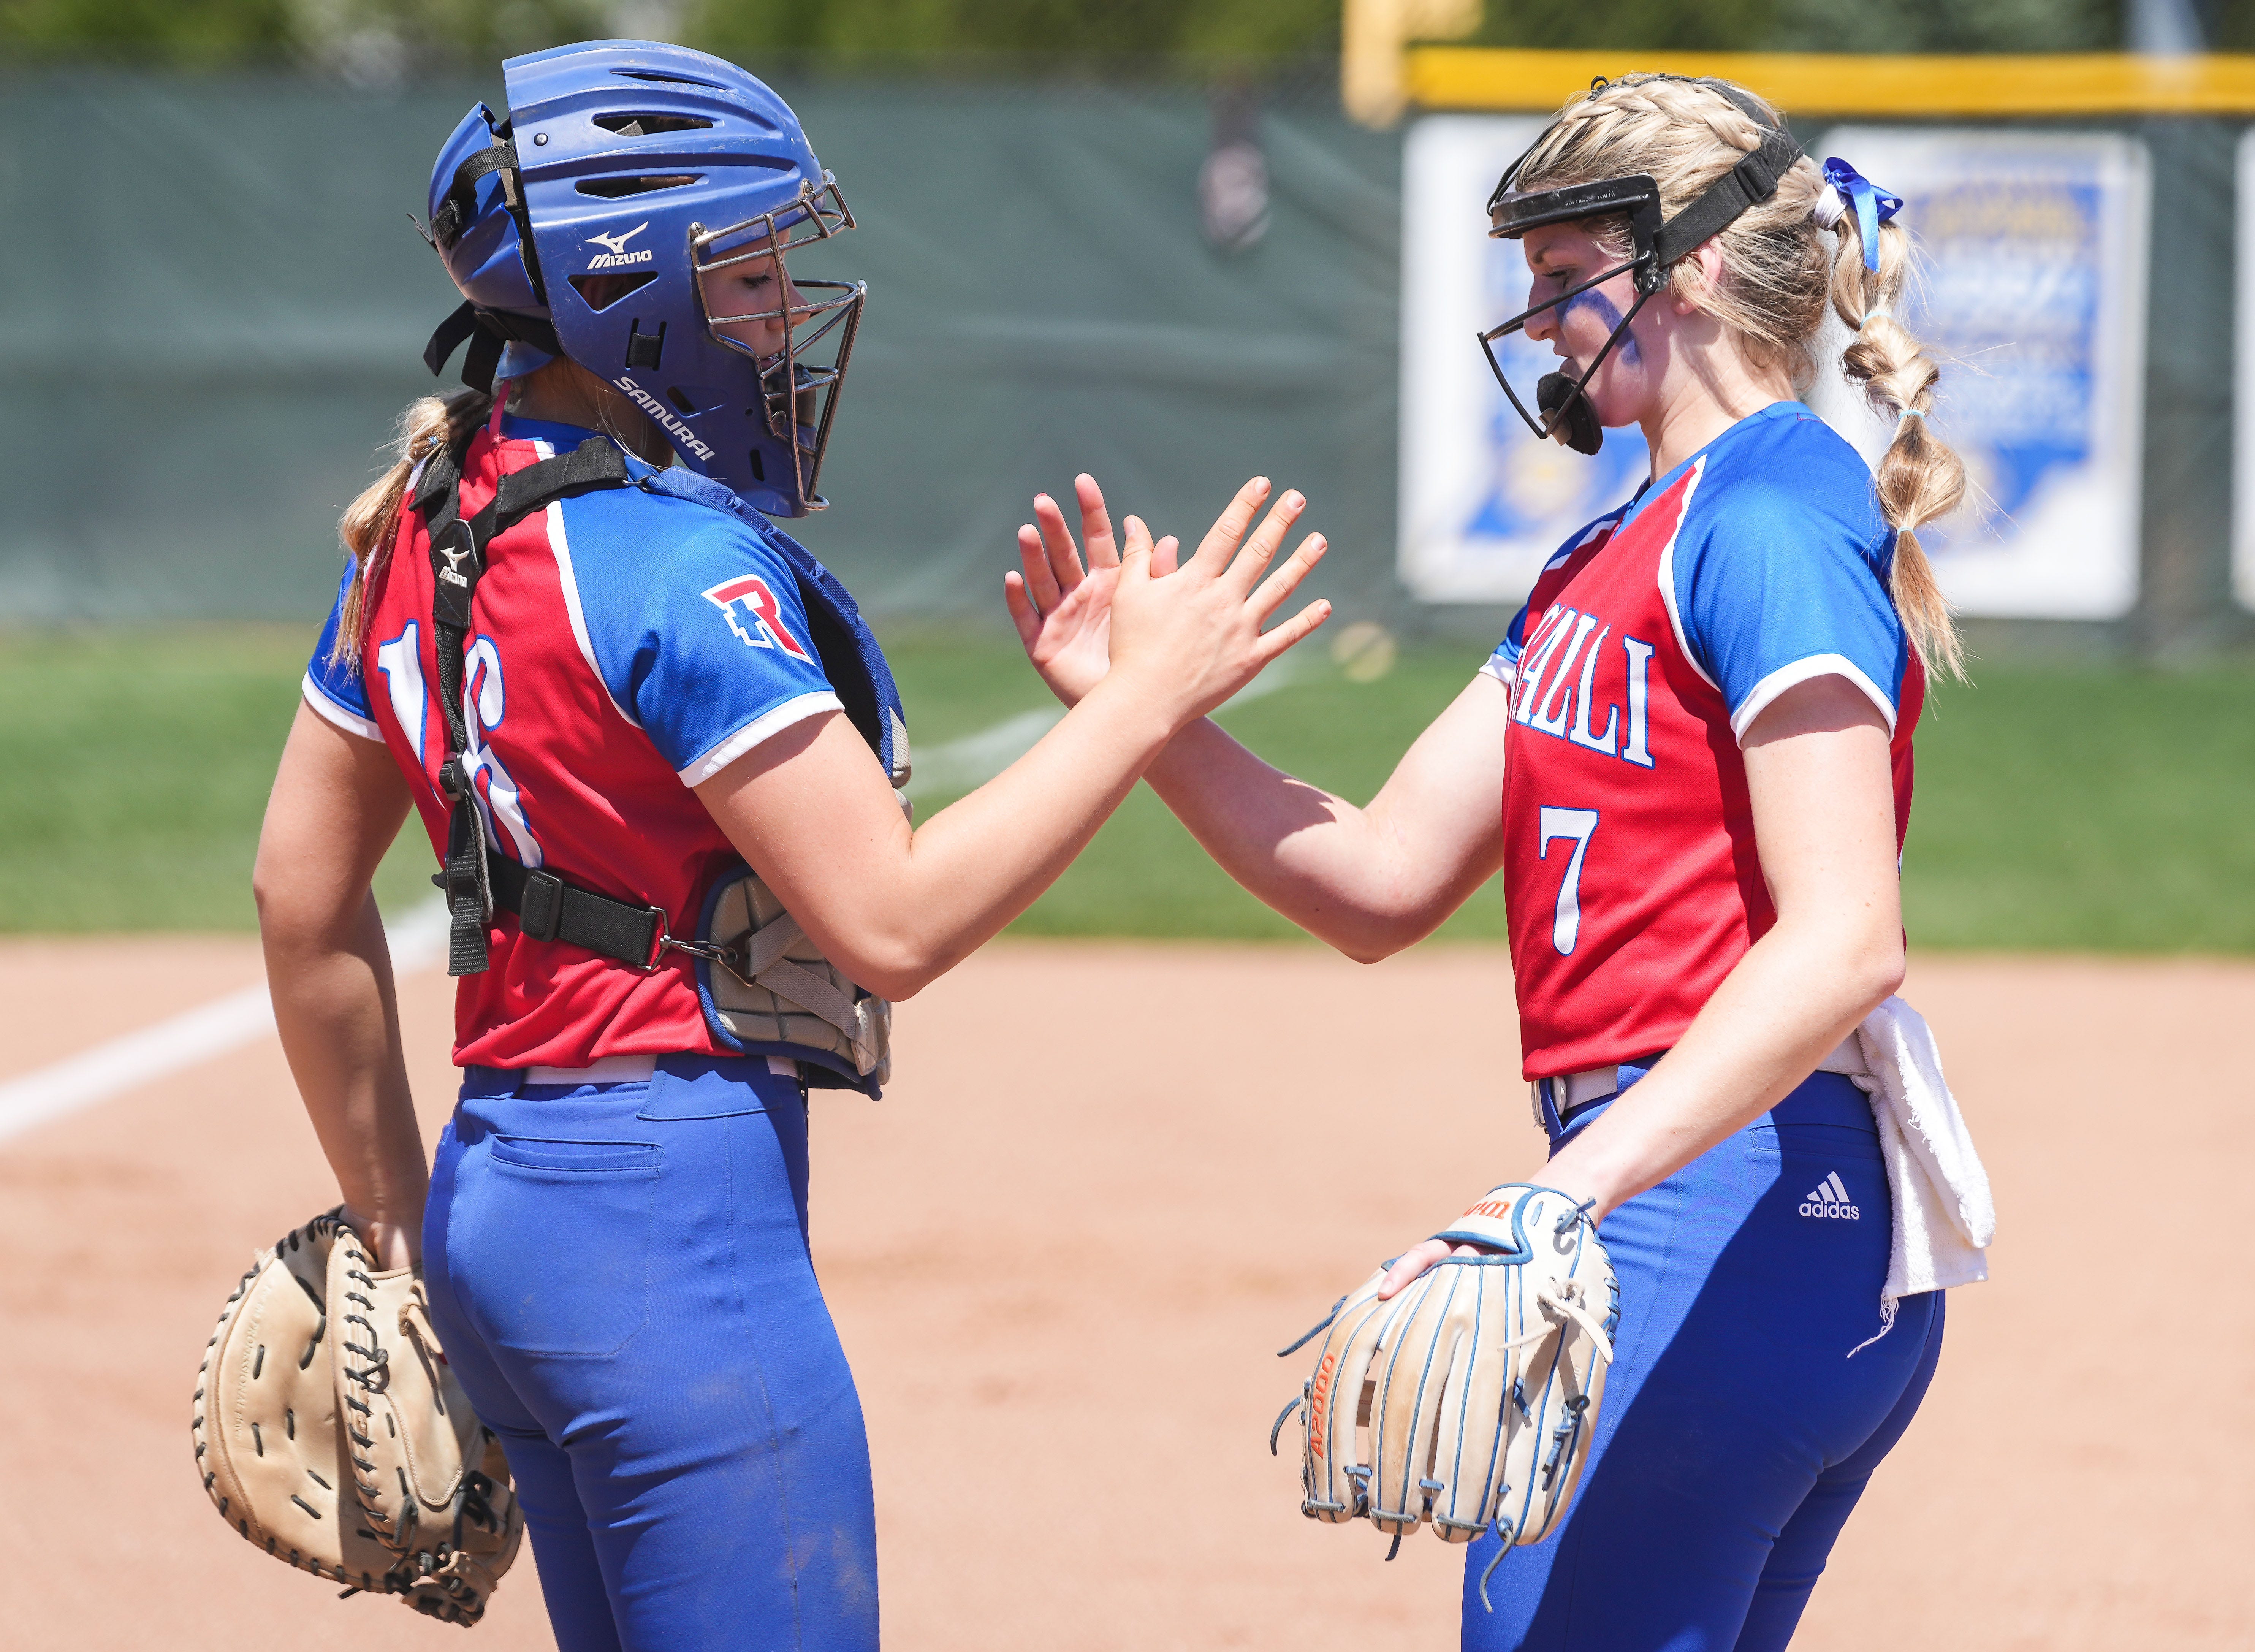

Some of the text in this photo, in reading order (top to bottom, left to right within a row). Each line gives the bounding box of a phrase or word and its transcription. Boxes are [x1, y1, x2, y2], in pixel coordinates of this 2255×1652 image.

[613, 377, 715, 461] SAMURAI
[378, 618, 544, 870] 16
[1539, 805, 1600, 956] 7
[1799, 1200, 1860, 1220] adidas
[1310, 1352, 1335, 1460] A2000
